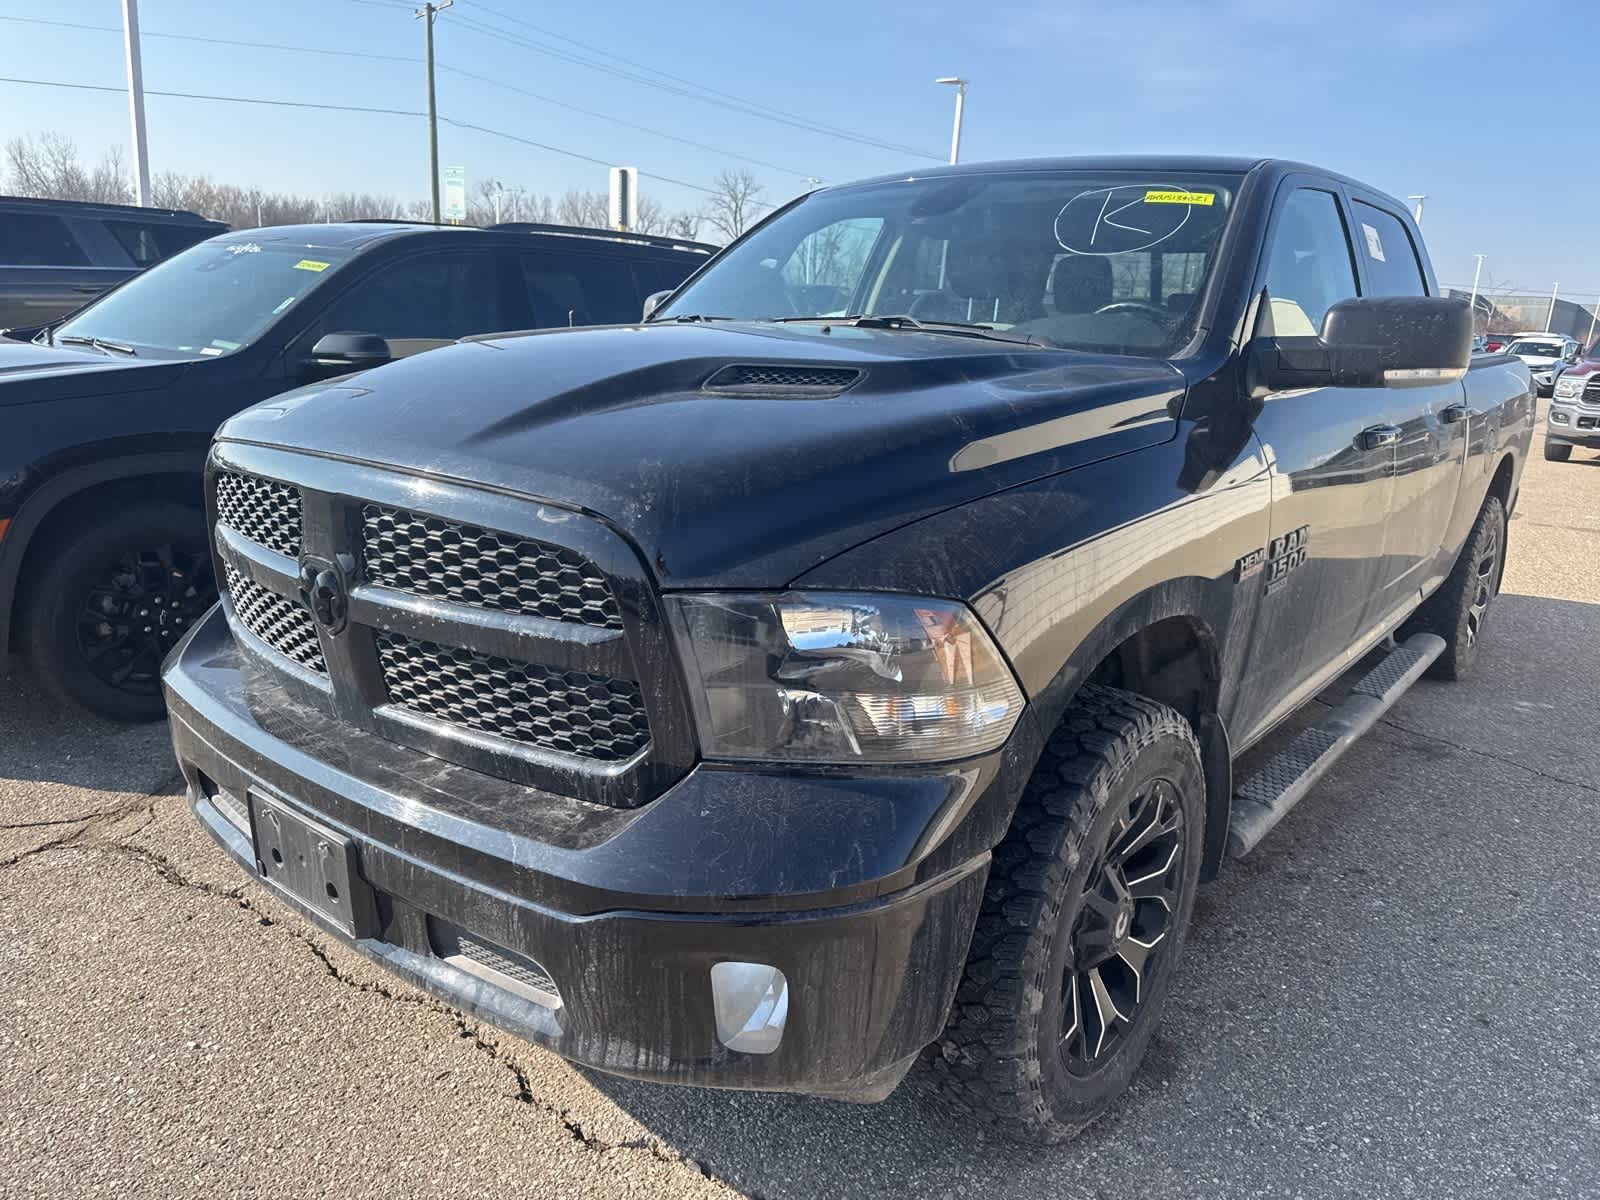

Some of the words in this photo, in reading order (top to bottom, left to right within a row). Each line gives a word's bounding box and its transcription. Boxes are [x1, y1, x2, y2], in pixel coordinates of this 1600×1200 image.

[1090, 191, 1153, 245] K
[1270, 526, 1310, 562] RAM
[1268, 548, 1306, 580] 1500
